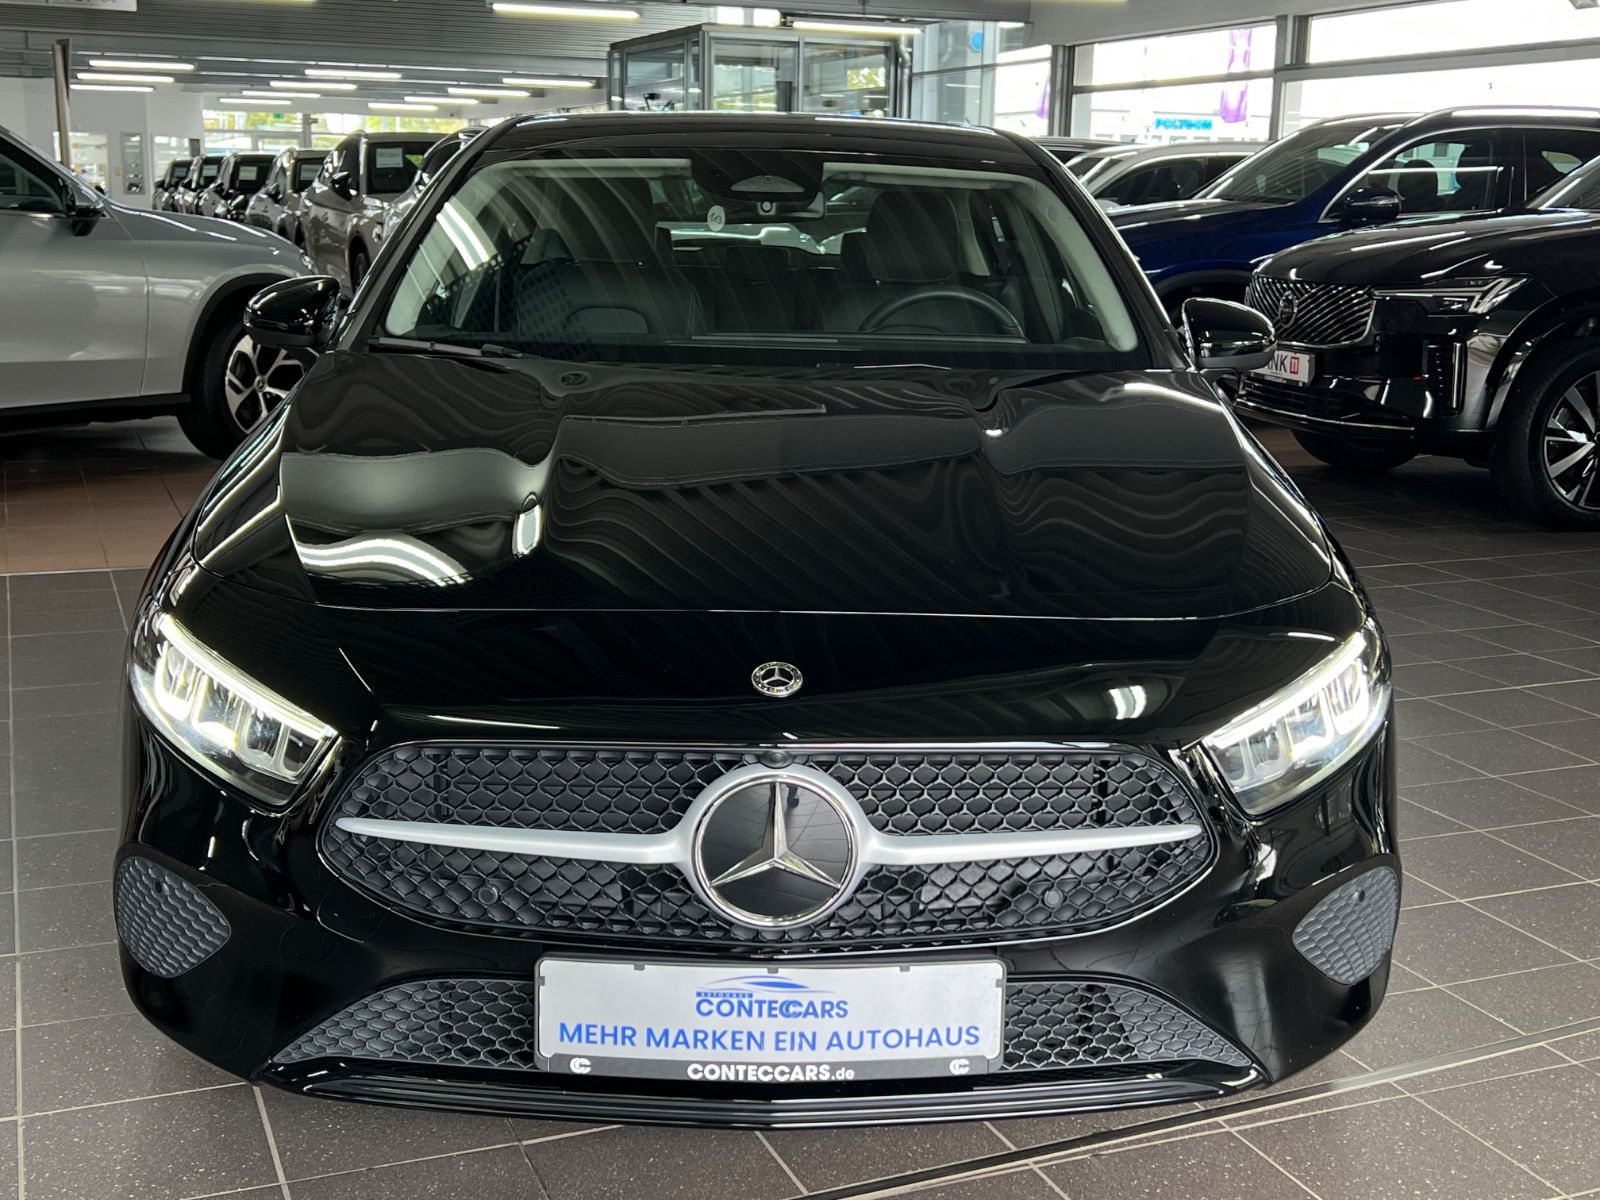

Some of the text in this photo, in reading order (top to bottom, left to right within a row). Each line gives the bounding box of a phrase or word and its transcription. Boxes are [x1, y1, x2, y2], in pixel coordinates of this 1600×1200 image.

[1267, 354, 1288, 373] NK
[695, 999, 849, 1019] CONTECCARS
[559, 1022, 980, 1052] MEHR MARKEN EIN AUTOHAUS
[687, 1063, 856, 1082] CONTECCARS.de
